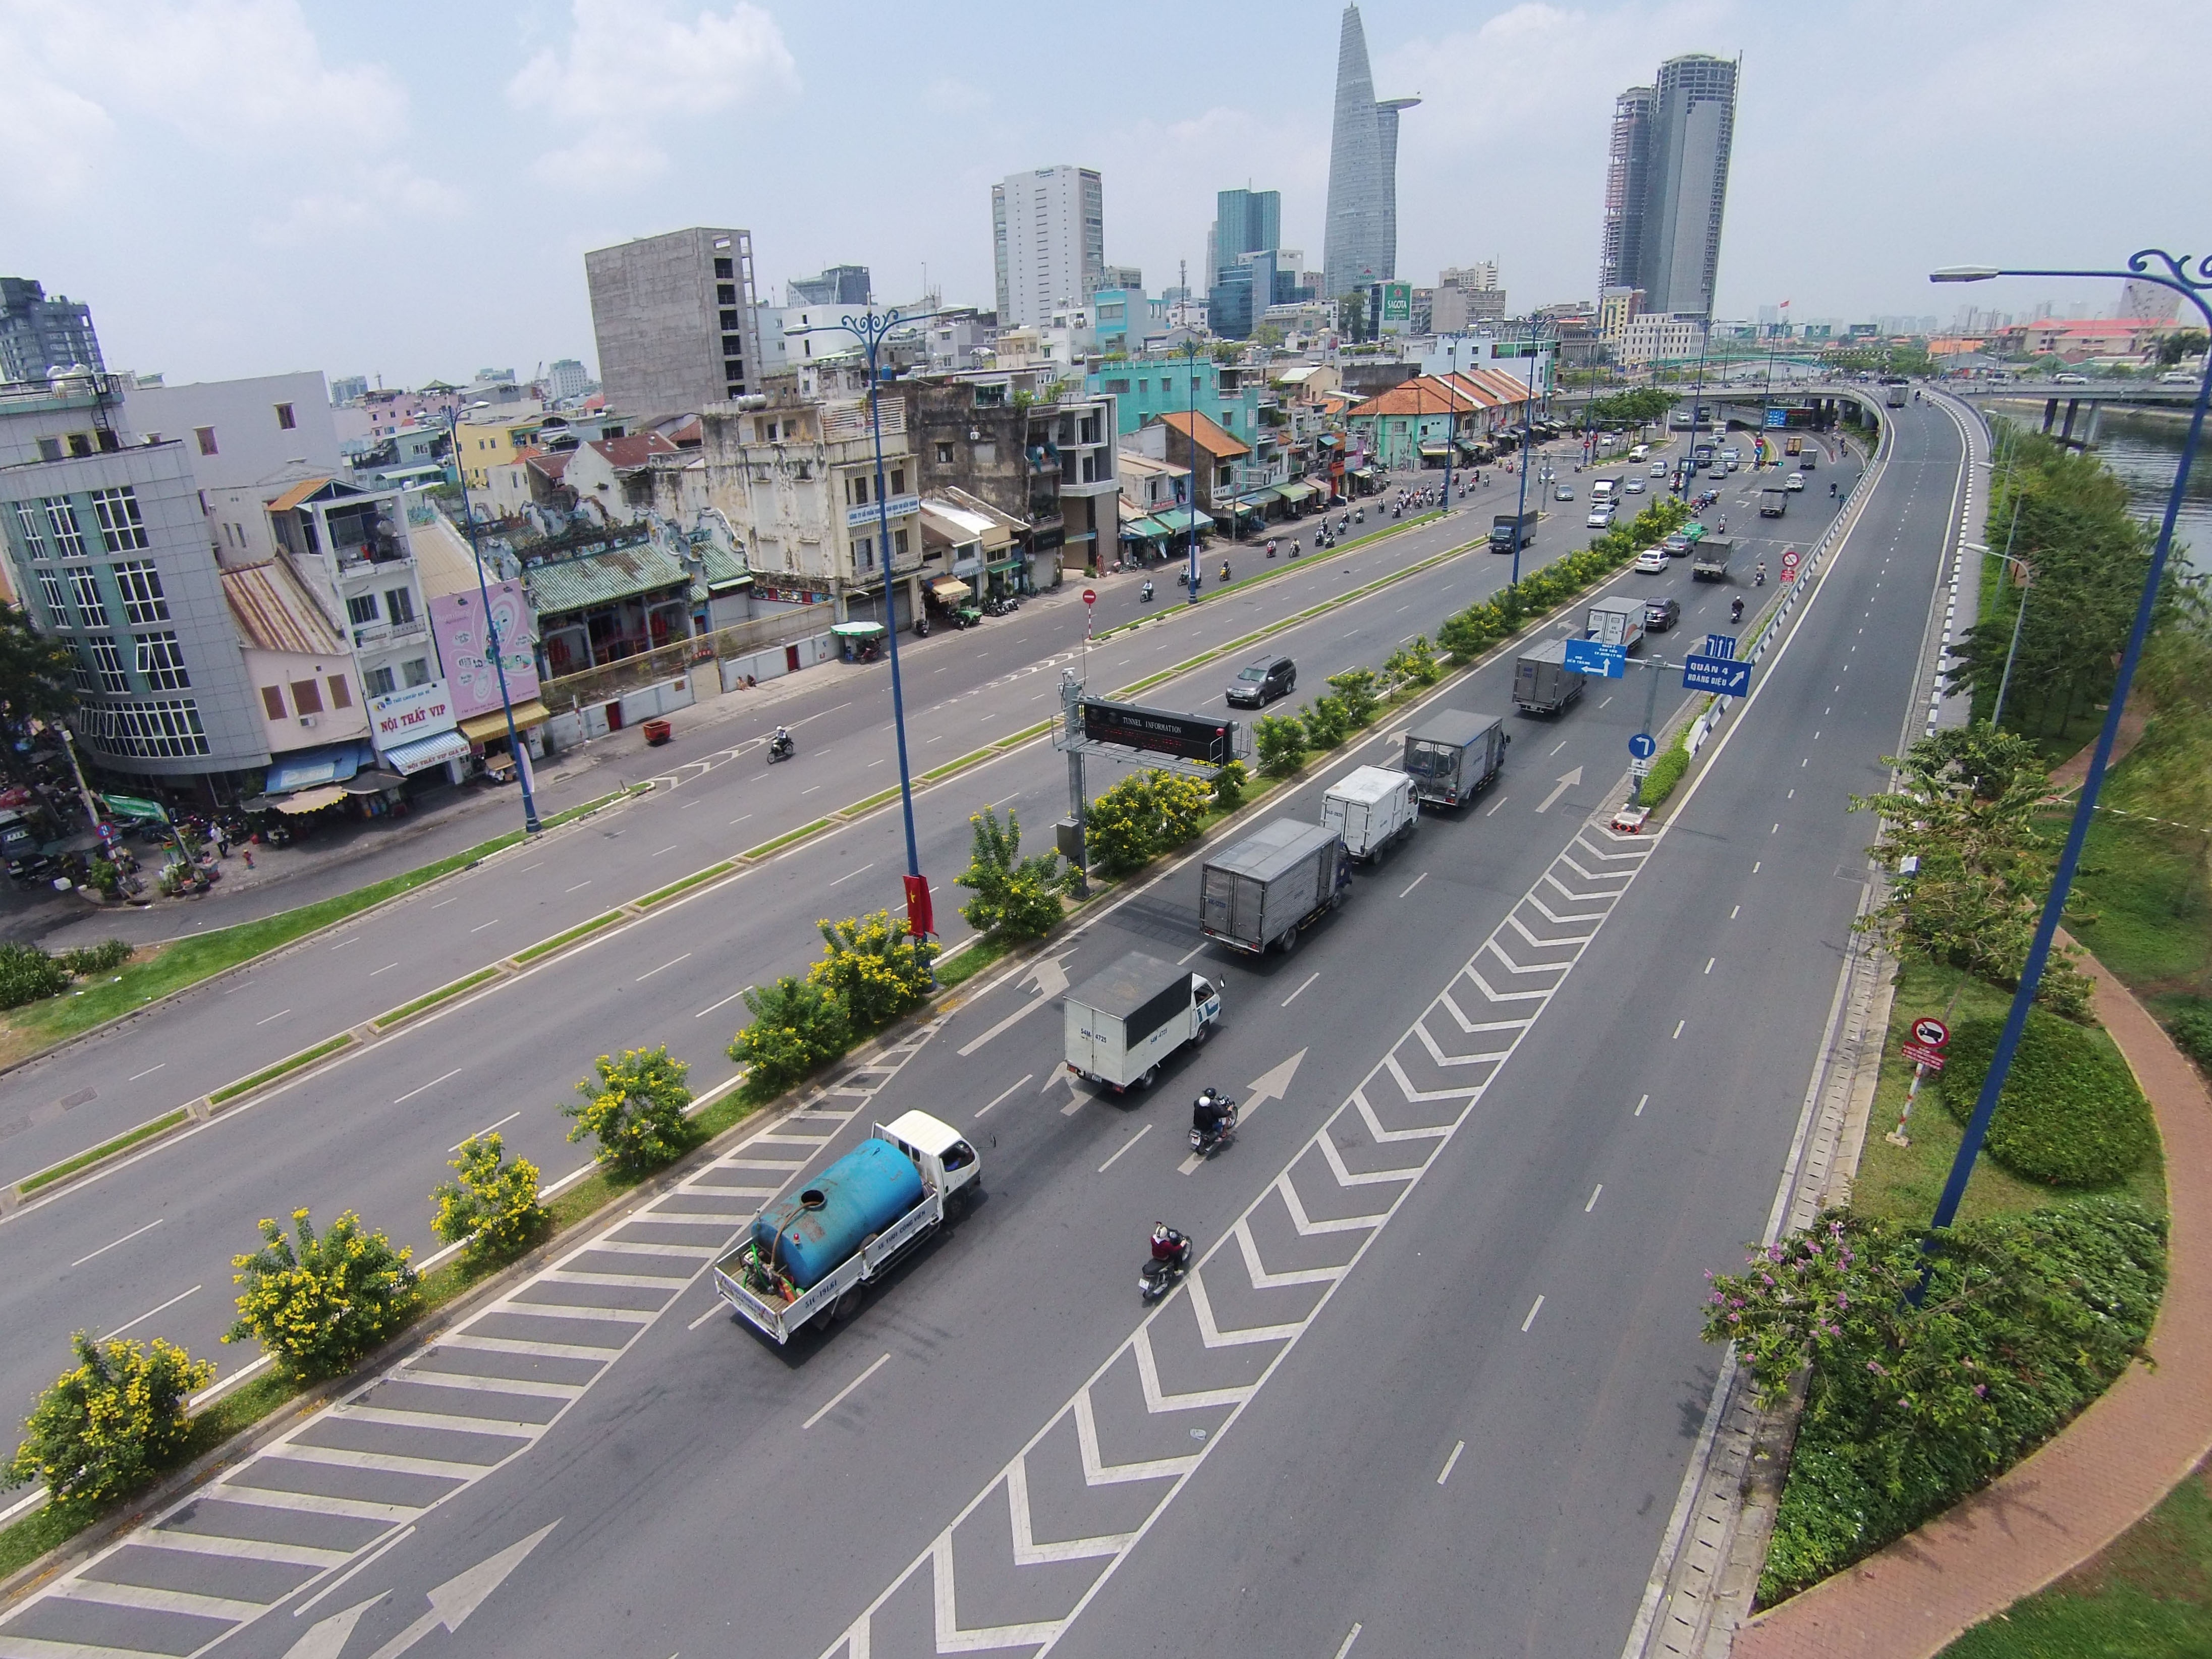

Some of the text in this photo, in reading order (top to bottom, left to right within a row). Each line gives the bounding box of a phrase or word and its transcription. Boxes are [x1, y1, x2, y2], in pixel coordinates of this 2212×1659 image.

[1387, 300, 1407, 309] SAGOTA
[1690, 662, 1719, 673] QUẬN
[1687, 673, 1727, 686] HOÀNG DIỆU
[380, 717, 398, 732] NỘI
[401, 706, 426, 726] THẤT
[429, 704, 446, 717] VIP
[1123, 717, 1182, 733] TUNNEL INFORMATION
[877, 1241, 884, 1251] XE
[899, 1220, 913, 1234] CÔNG
